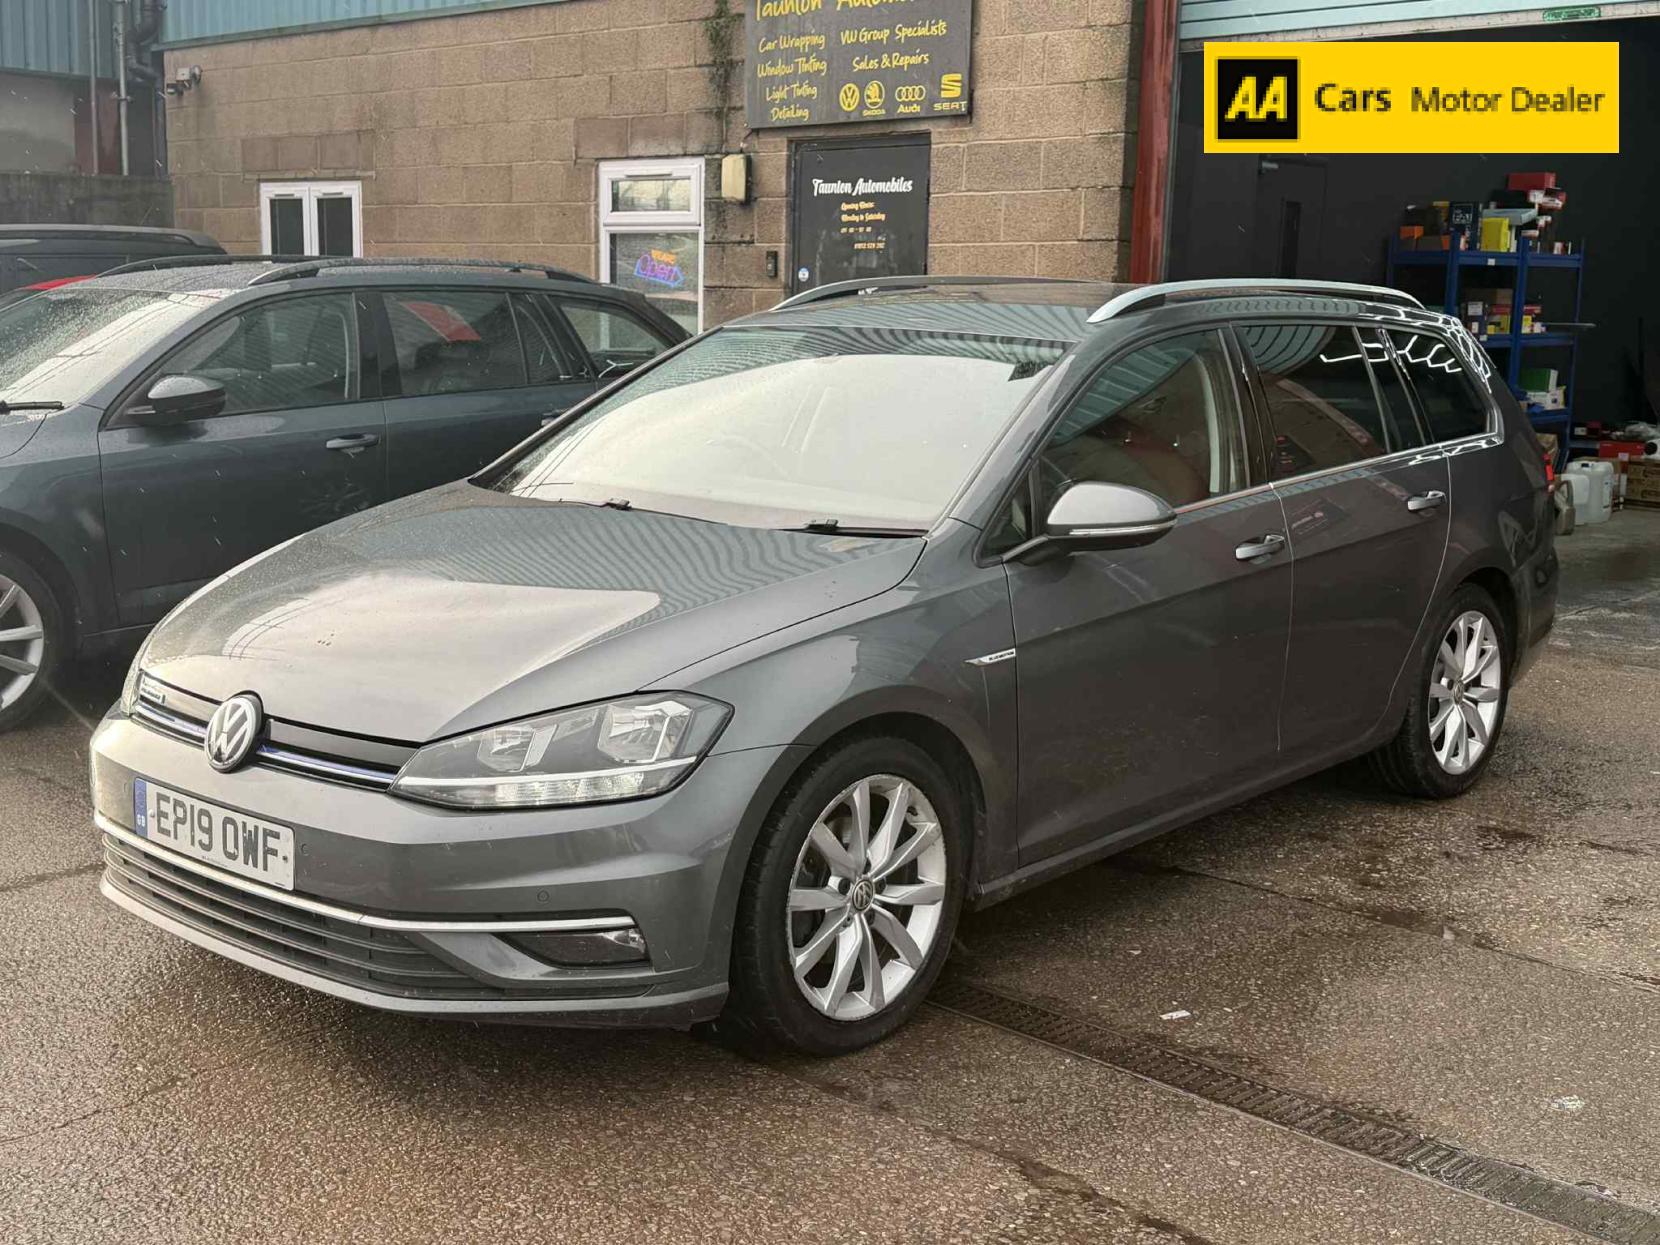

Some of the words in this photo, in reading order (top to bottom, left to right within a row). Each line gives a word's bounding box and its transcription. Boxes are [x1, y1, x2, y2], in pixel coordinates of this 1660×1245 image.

[759, 37, 777, 53] Car
[780, 29, 826, 52] Wrapping
[859, 28, 890, 45] Group
[757, 60, 794, 78] Window
[795, 53, 828, 76] Tinting
[852, 56, 879, 72] Sales
[880, 54, 891, 68] &
[891, 48, 929, 72] Repairs
[766, 84, 790, 103] Light
[791, 80, 817, 99] Tinting
[770, 104, 810, 122] Detailing
[897, 104, 921, 114] Audi
[812, 178, 852, 197] Taunton
[852, 176, 913, 196] Automobiles
[156, 791, 213, 852] EP19
[222, 816, 280, 872] OWF
